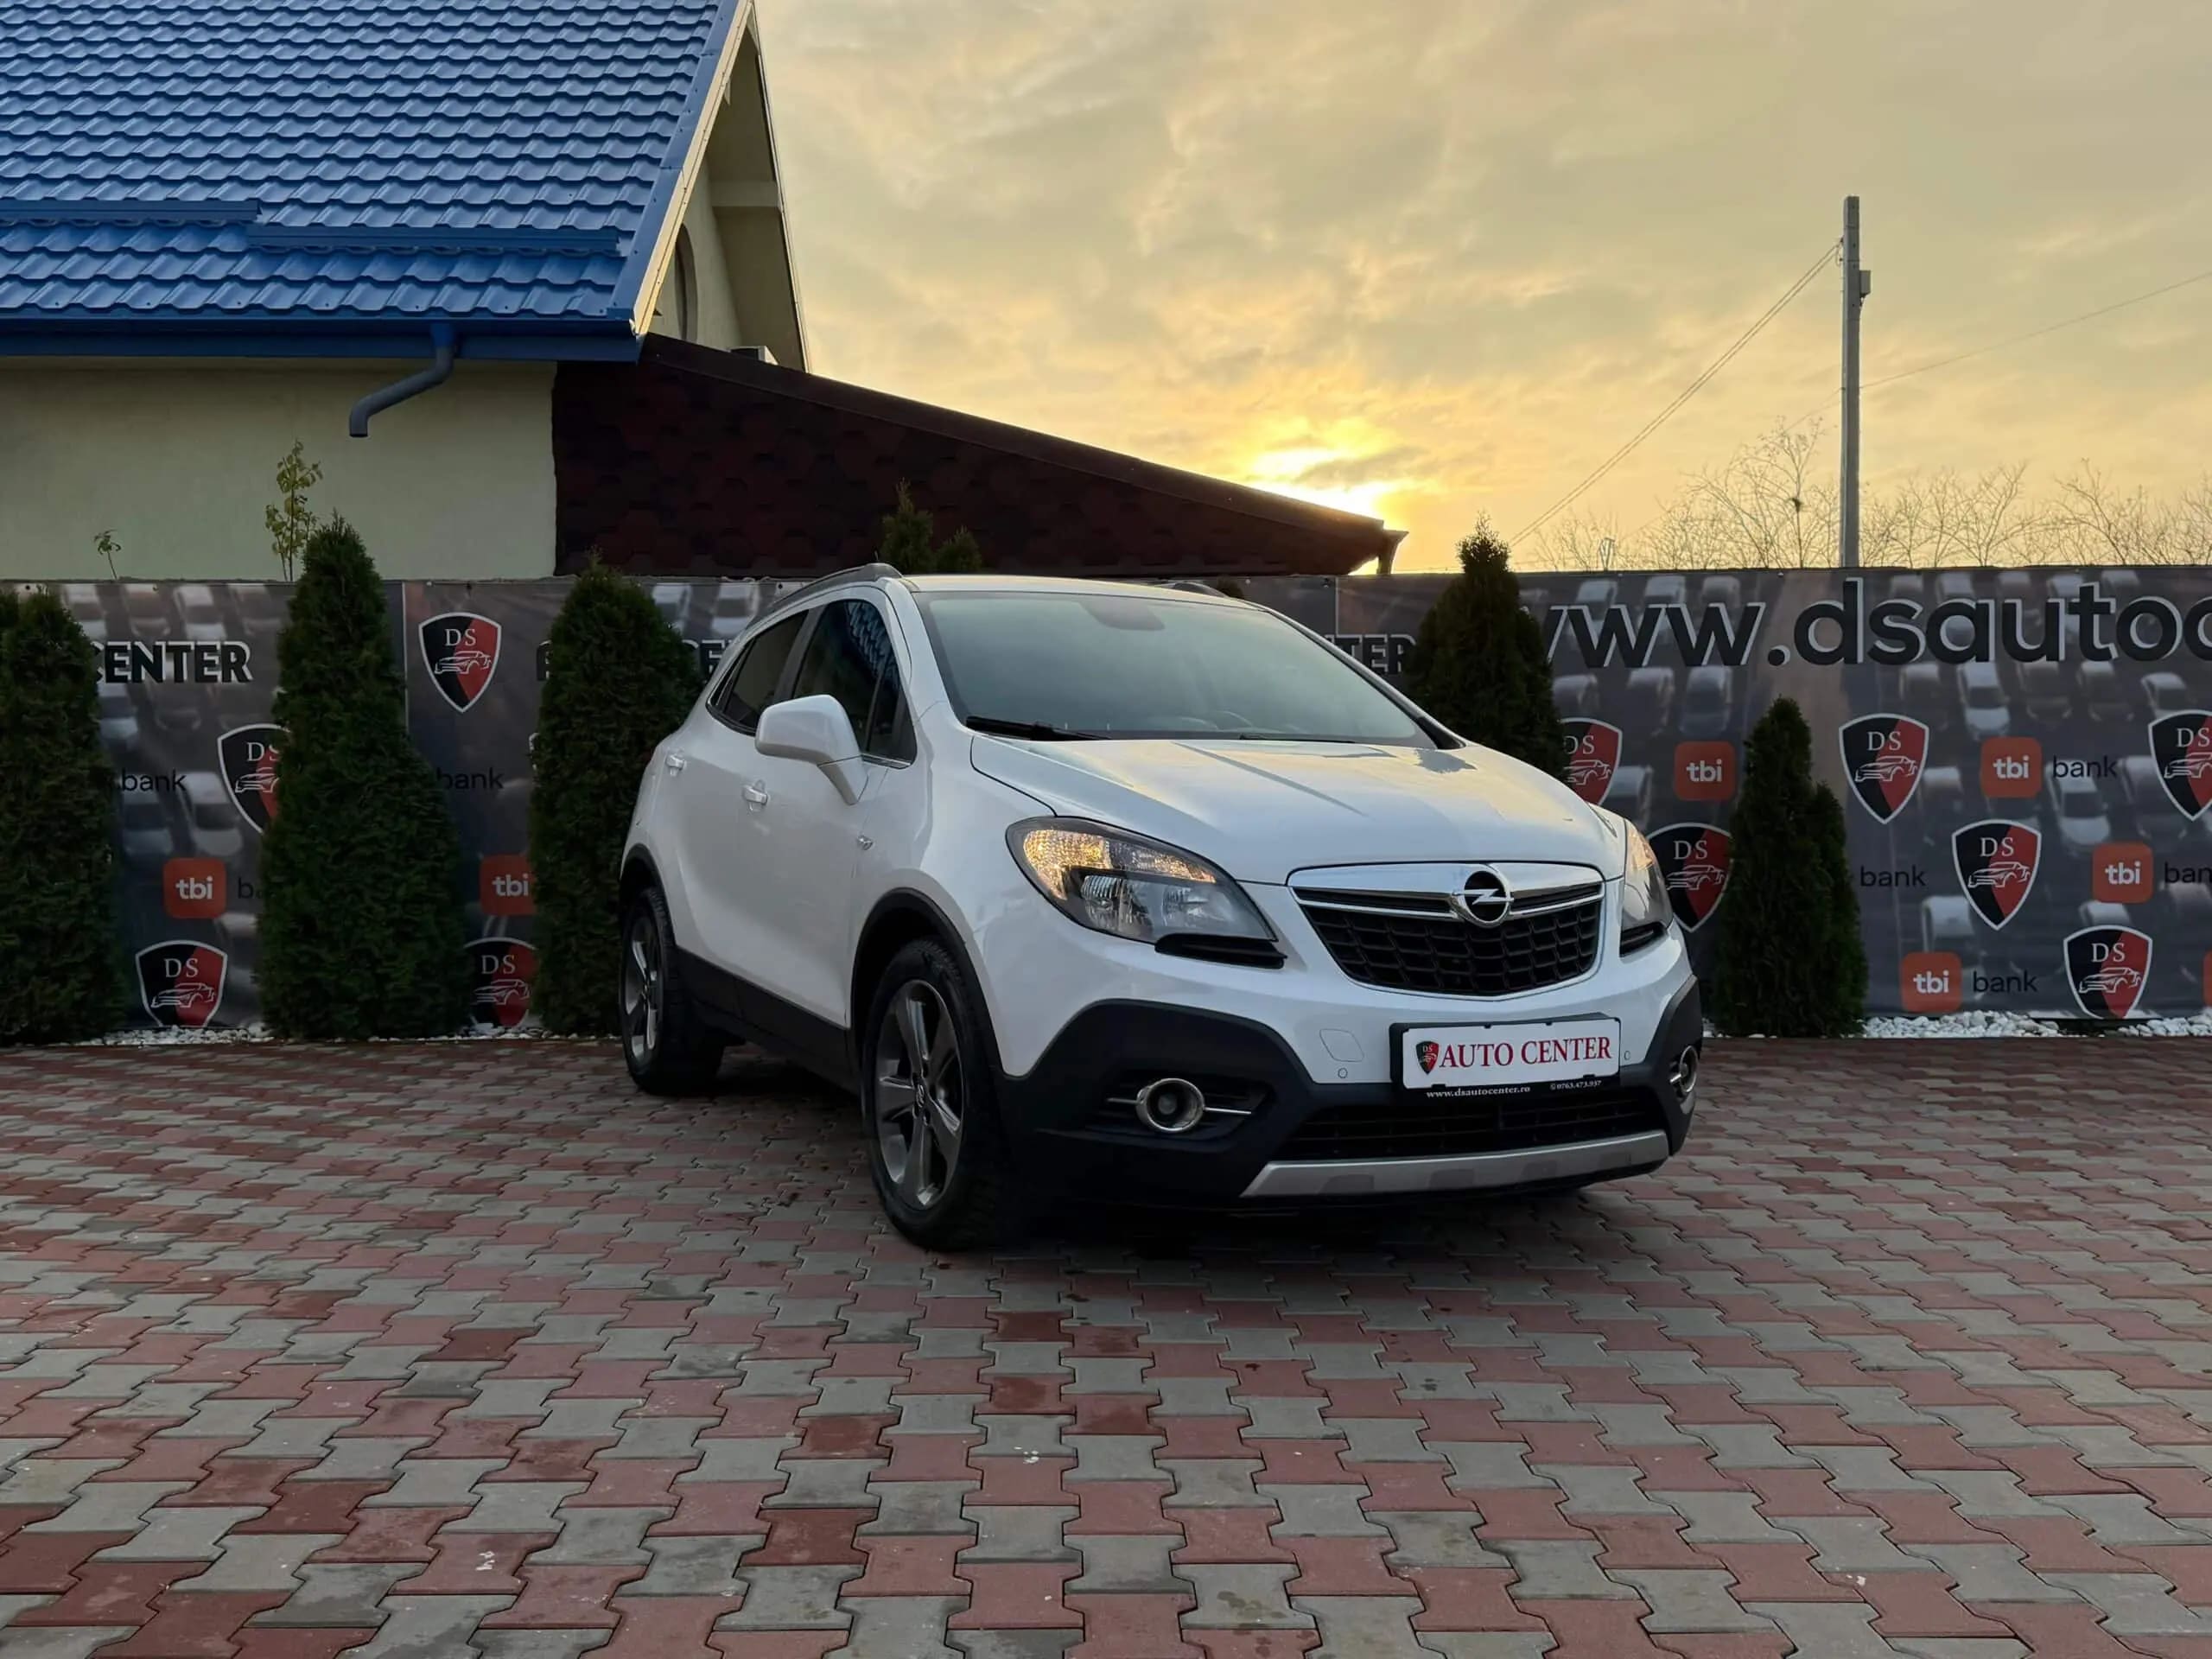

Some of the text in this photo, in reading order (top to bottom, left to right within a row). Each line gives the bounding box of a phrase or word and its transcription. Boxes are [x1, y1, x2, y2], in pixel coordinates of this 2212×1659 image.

[445, 628, 477, 646] DS
[91, 640, 254, 683] ENTER
[1868, 731, 1901, 751] DS
[2177, 728, 2210, 747] DS
[1686, 761, 1722, 783] tbi
[1993, 755, 2119, 779] tbi bank
[122, 767, 188, 791] bank
[1674, 840, 1708, 860] DS
[1980, 837, 2014, 857] DS
[1860, 866, 1926, 887] bank
[2105, 862, 2141, 885] tbi
[175, 875, 213, 899] tbi
[492, 873, 529, 897] tbi
[2092, 943, 2126, 963] DS
[164, 957, 199, 978] DS
[481, 954, 517, 975] DS
[1913, 971, 2038, 994] tbi bank
[1439, 1035, 1612, 1068] AUTO CENTER
[1426, 1085, 1531, 1099] www.dsautocenter.ro
